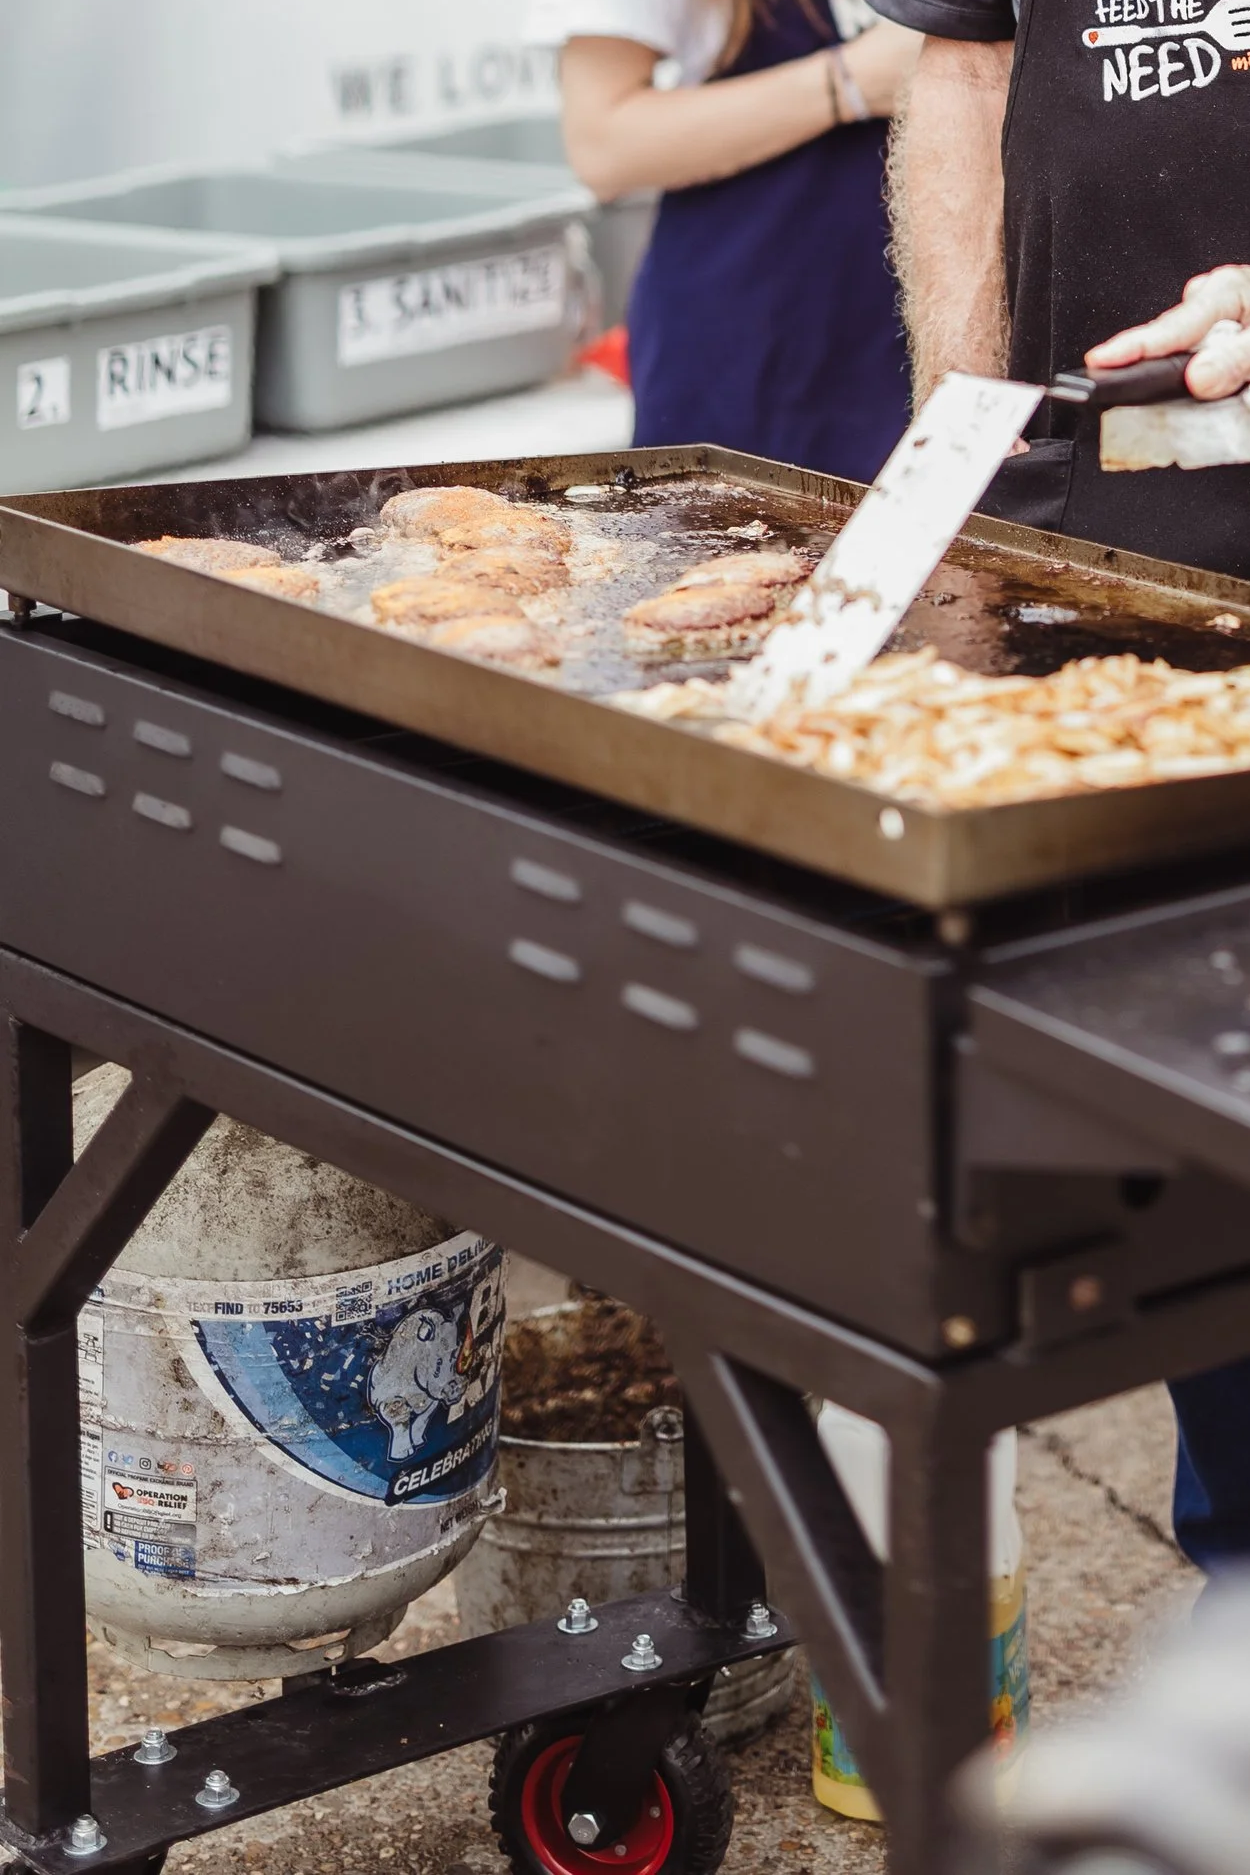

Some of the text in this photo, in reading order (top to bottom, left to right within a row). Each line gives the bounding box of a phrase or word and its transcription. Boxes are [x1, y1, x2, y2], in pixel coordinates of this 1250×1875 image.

[1103, 37, 1221, 102] NEED
[107, 329, 230, 399] RINSE
[387, 1262, 444, 1295] HOME
[214, 1301, 243, 1315] FIND
[393, 1417, 493, 1496] CELEBRATING
[107, 1469, 127, 1478] OFFICIAL
[127, 1473, 148, 1482] PROPANE
[136, 1489, 188, 1502] OPERATION
[157, 1500, 187, 1510] RELIEF
[138, 1542, 170, 1555] PROOF
